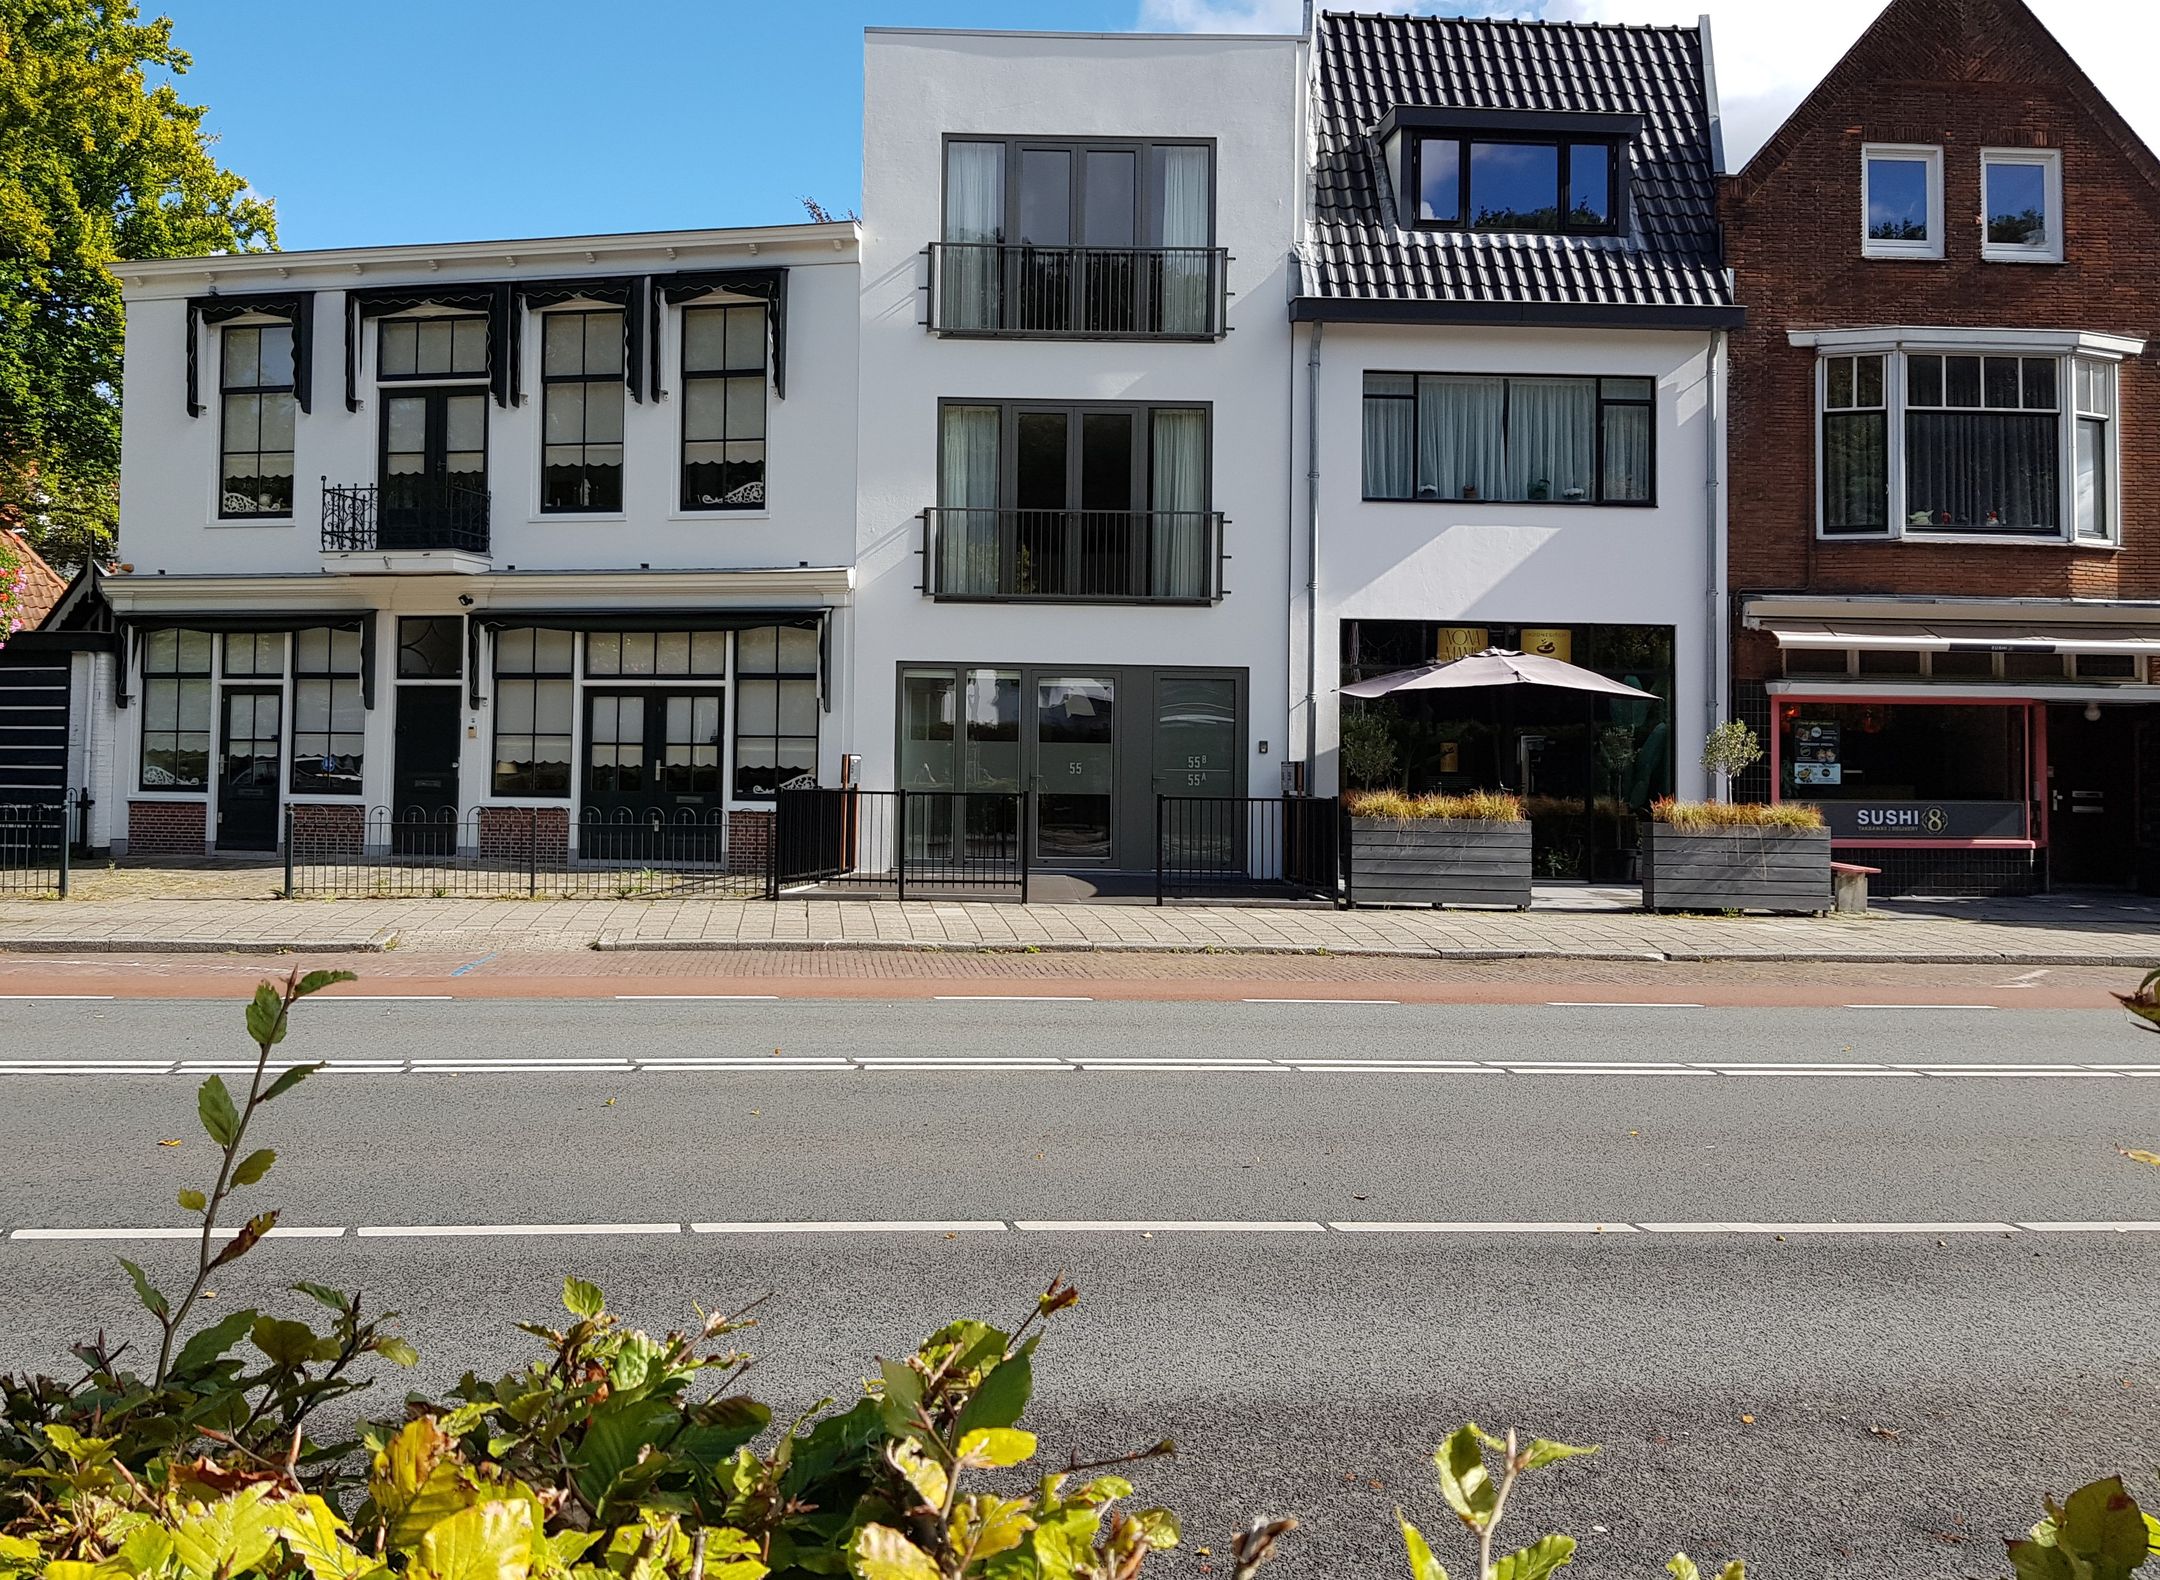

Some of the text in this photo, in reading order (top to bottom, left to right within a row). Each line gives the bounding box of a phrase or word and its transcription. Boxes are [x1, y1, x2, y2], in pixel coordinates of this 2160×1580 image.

[1188, 754, 1207, 768] 55B
[1069, 762, 1082, 775] 55
[1188, 772, 1207, 786] 55A
[1857, 808, 1942, 831] SUSHI 8
